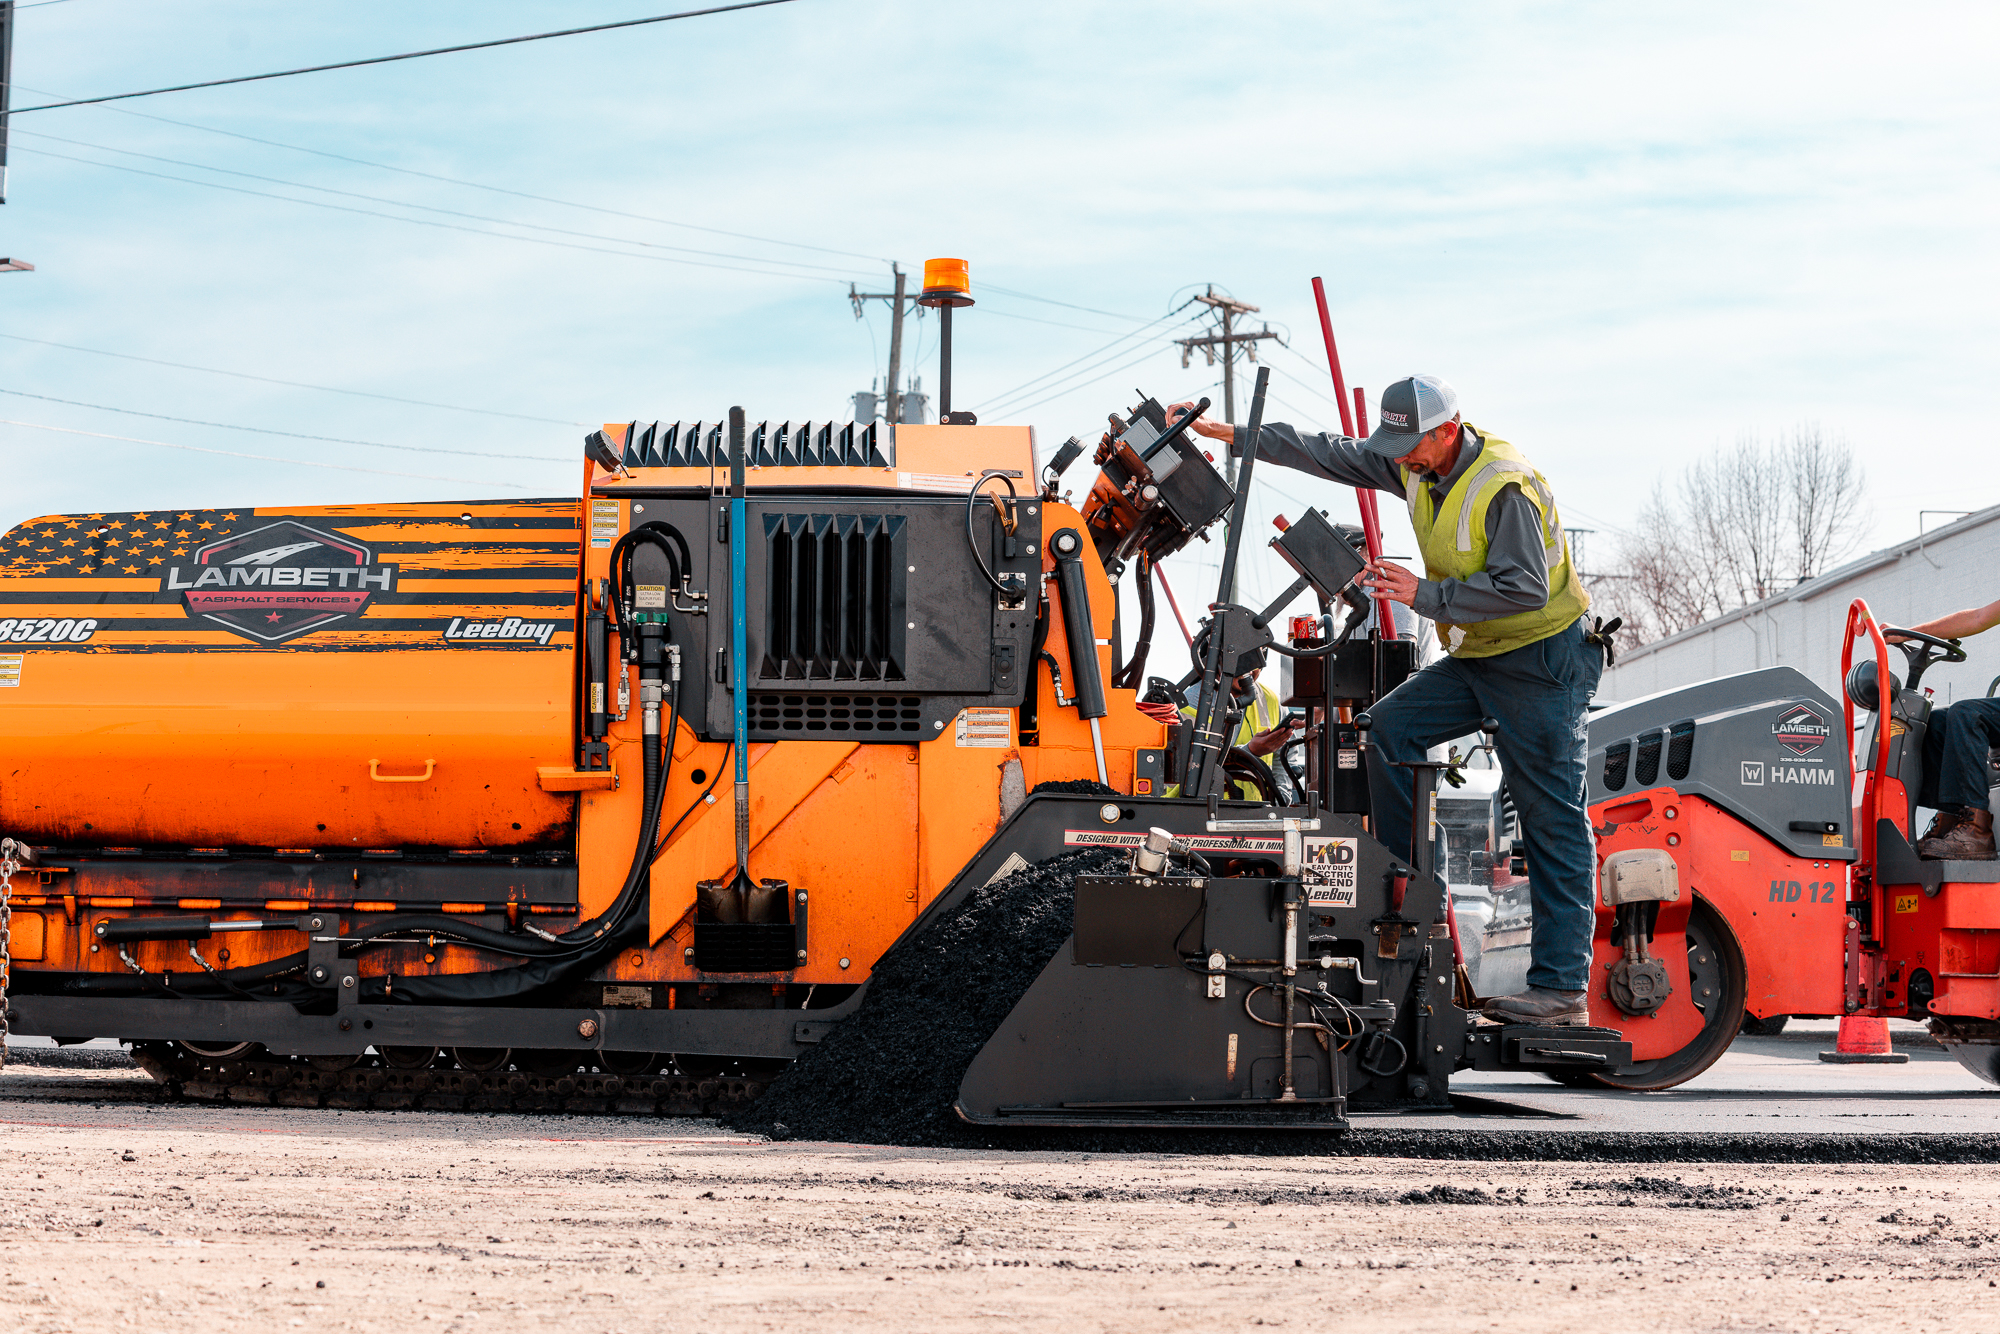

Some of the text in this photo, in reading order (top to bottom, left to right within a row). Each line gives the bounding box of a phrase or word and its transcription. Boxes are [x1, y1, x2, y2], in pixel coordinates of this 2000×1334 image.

[167, 567, 392, 590] LAMBETH
[0, 619, 98, 642] 8520C
[445, 618, 556, 645] LeeBoy
[1771, 723, 1830, 737] LAMBETH
[1771, 766, 1835, 785] HAMM
[1075, 834, 1118, 844] DESIGNED
[1120, 836, 1141, 845] WITH
[1191, 839, 1253, 849] PROFESSIONAL
[1254, 841, 1264, 849] IN
[1265, 842, 1284, 850] MIN
[1306, 878, 1354, 887] LEEND
[1768, 880, 1835, 903] HD 12
[1308, 887, 1354, 905] LeeBoy
